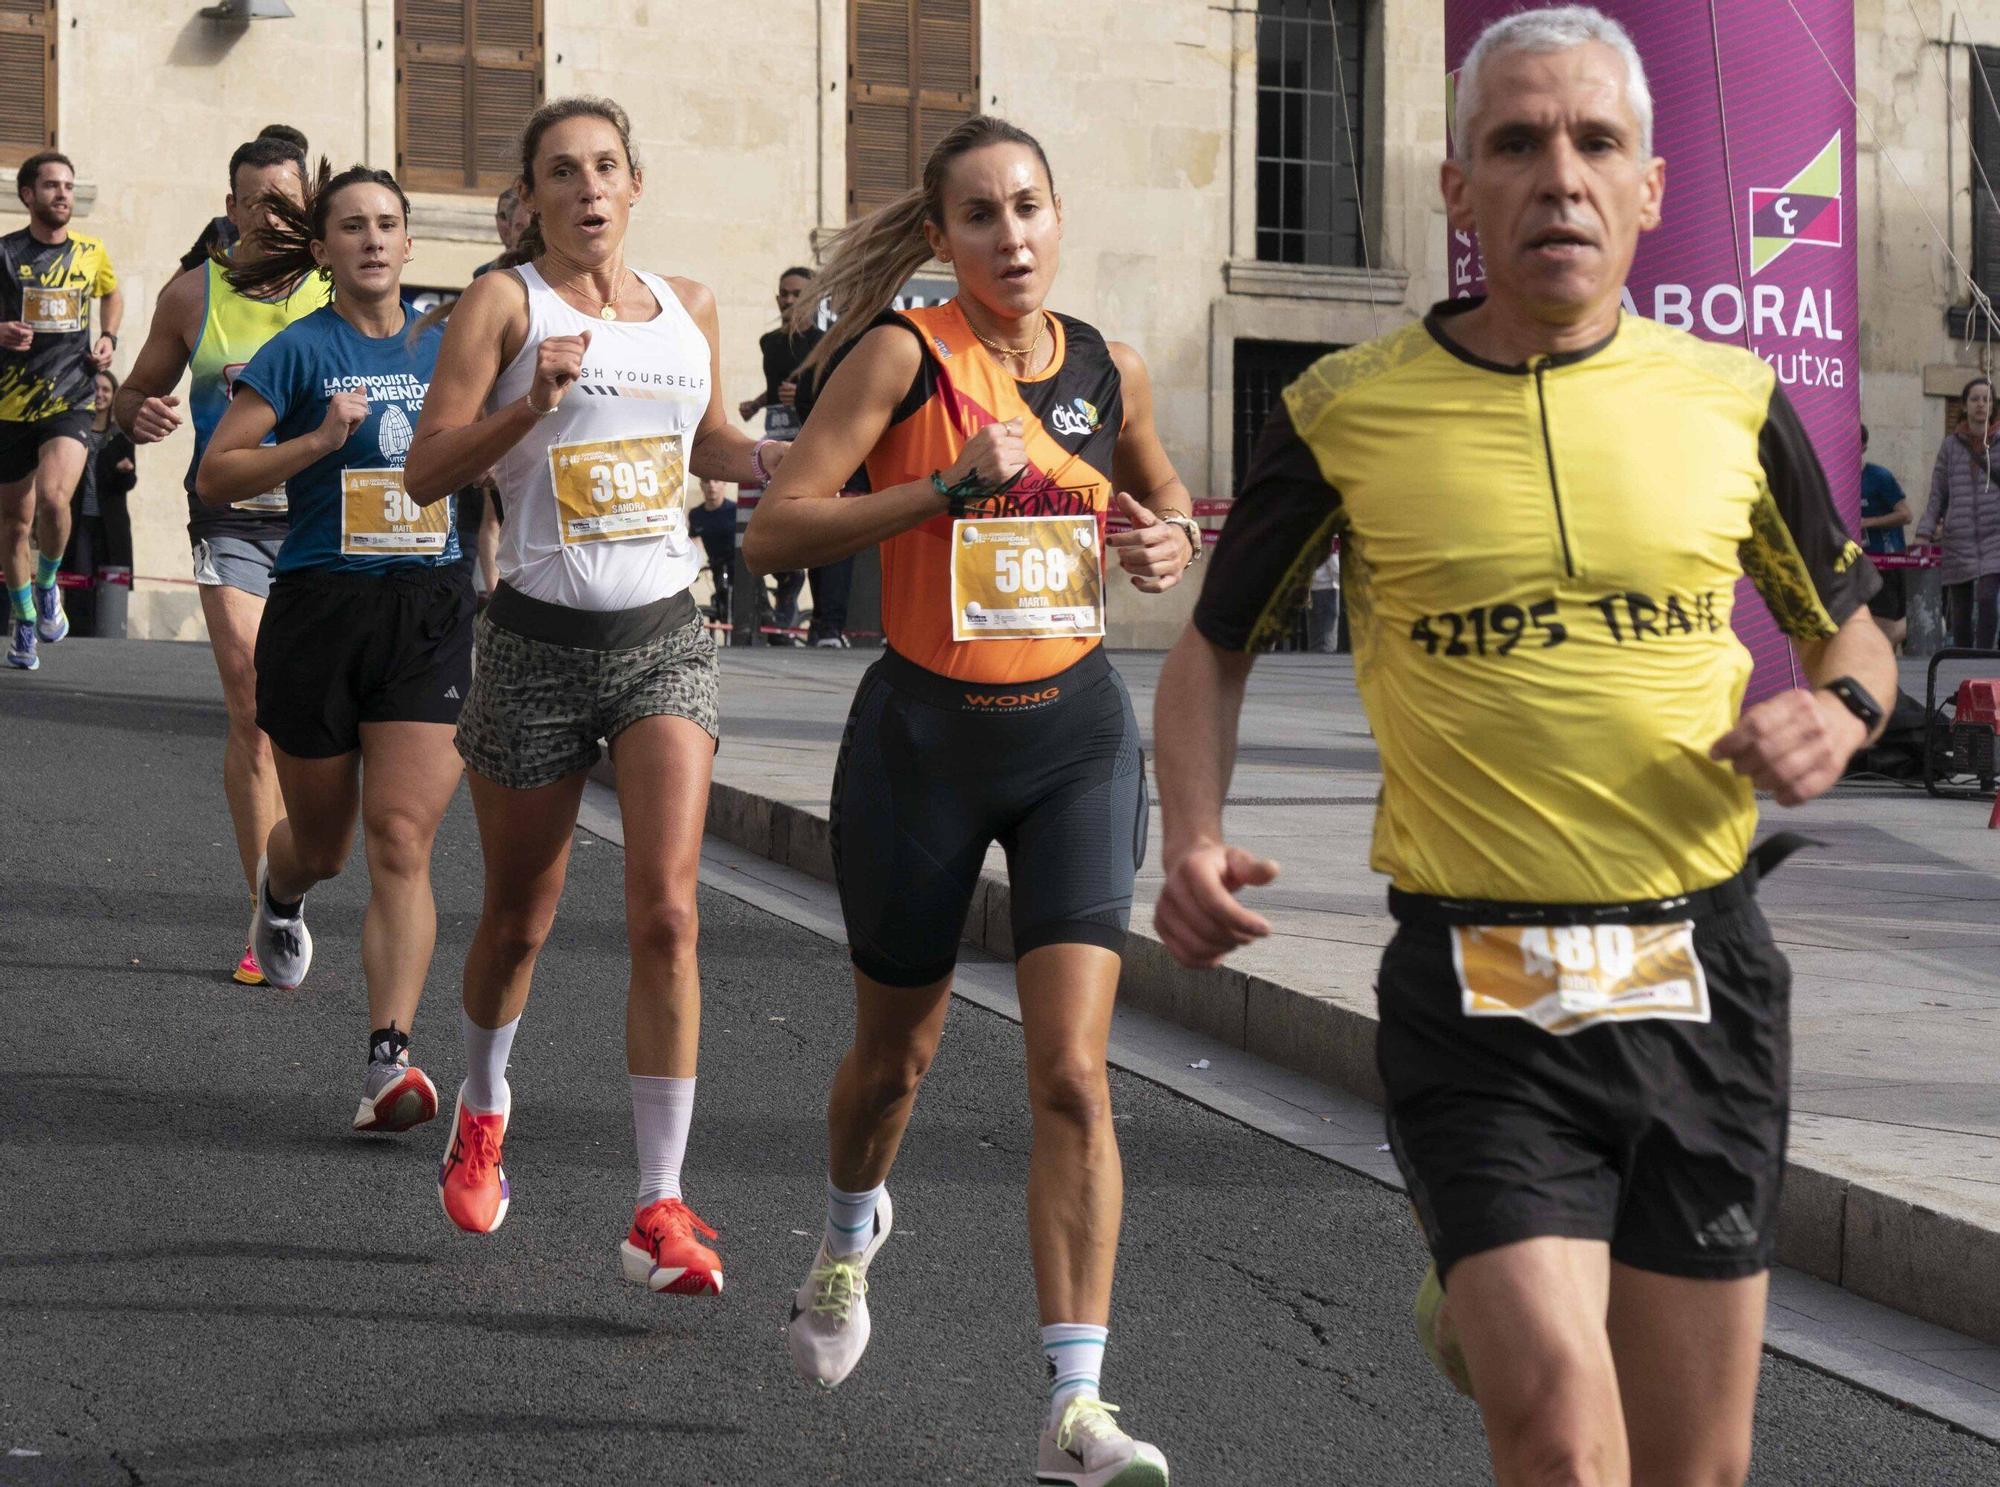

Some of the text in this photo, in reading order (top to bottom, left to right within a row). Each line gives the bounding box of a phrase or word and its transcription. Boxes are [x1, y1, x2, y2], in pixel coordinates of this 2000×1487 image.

[323, 374, 419, 389] LA CONQUISTA
[581, 368, 704, 389] SH YOURSELF
[350, 383, 430, 402] LMEND
[590, 460, 659, 503] 395
[611, 502, 646, 514] SANDRA
[972, 488, 1095, 518] ORONDA
[392, 524, 413, 533] MAITE
[995, 547, 1068, 593] 568
[1018, 597, 1050, 608] MARTA
[1411, 599, 1568, 657] 42195
[963, 687, 1060, 706] WONG
[1519, 925, 1636, 978] 480
